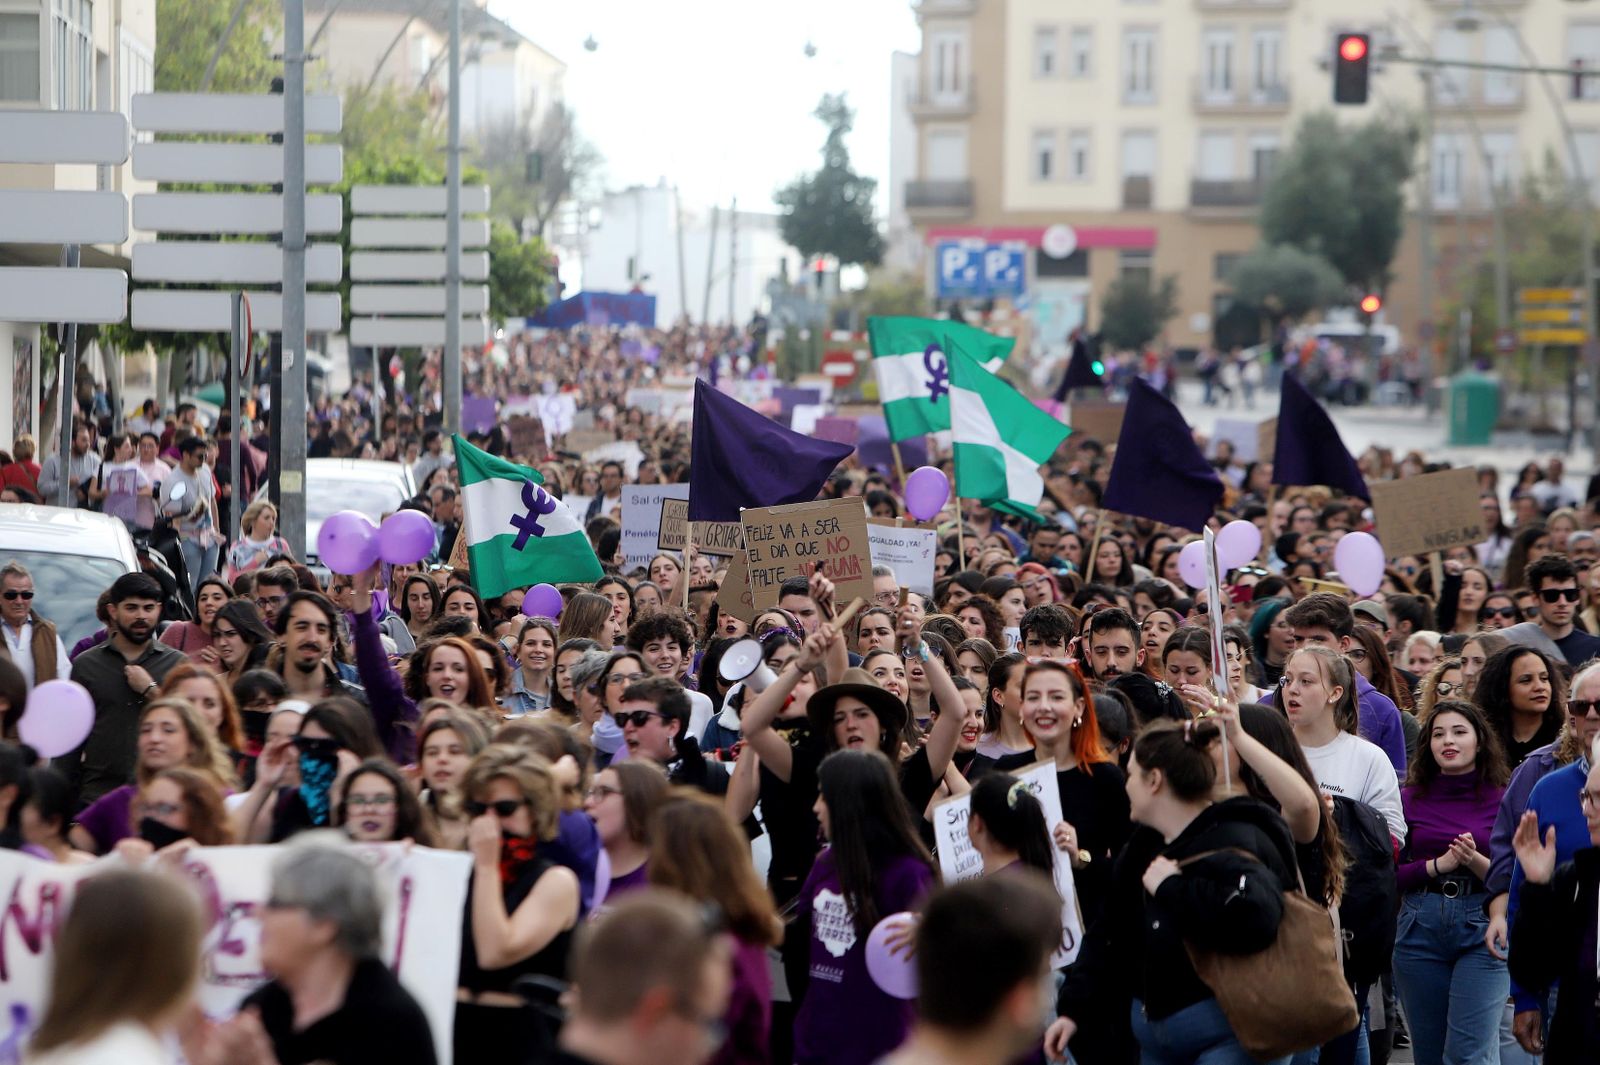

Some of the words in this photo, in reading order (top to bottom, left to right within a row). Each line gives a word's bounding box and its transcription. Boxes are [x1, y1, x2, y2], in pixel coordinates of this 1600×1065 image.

[631, 494, 649, 505] Sal
[624, 529, 658, 538] Penélo
[779, 523, 795, 539] VA
[801, 522, 810, 538] A
[814, 517, 841, 536] SER
[662, 533, 674, 545] NO
[706, 523, 741, 548] GRITAR
[749, 549, 763, 563] EL
[795, 540, 820, 557] QUE
[827, 535, 850, 555] NO
[625, 553, 653, 563] tamb
[752, 566, 786, 588] FALTE
[1319, 781, 1345, 793] breathe
